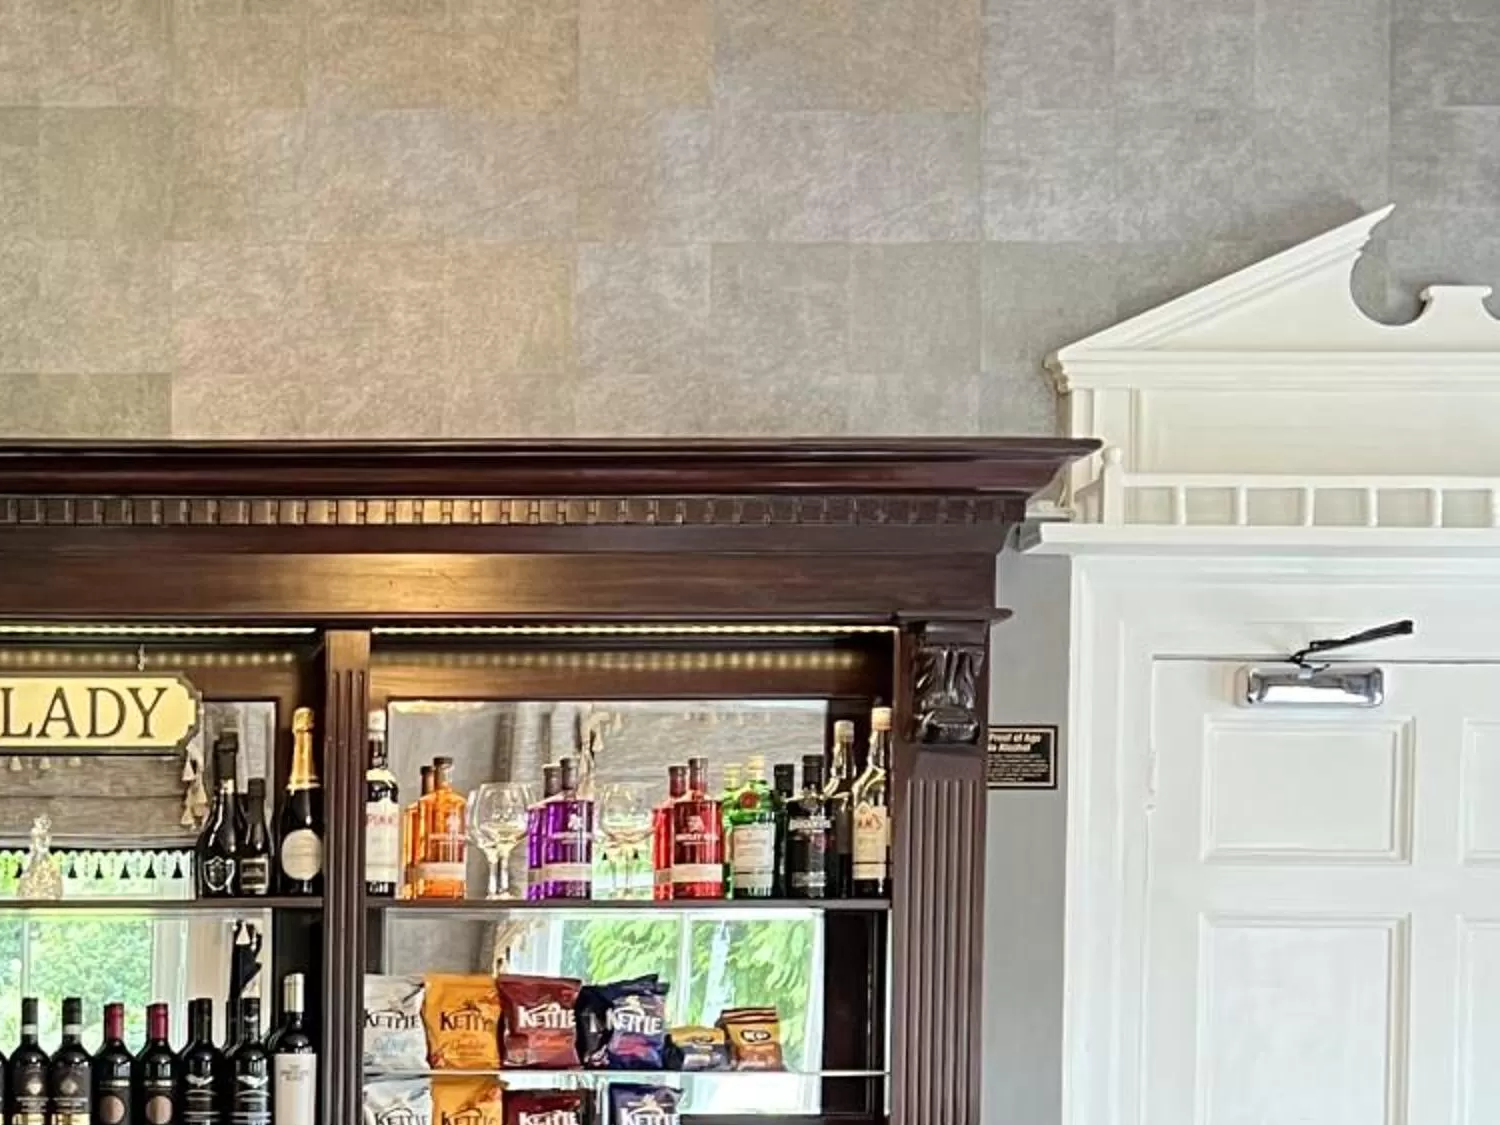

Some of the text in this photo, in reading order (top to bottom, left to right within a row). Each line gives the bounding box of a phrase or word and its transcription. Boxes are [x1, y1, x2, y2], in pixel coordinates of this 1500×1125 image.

[0, 686, 169, 739] LADY
[517, 1002, 577, 1029] KETTLE
[606, 1005, 662, 1035] KETTLE
